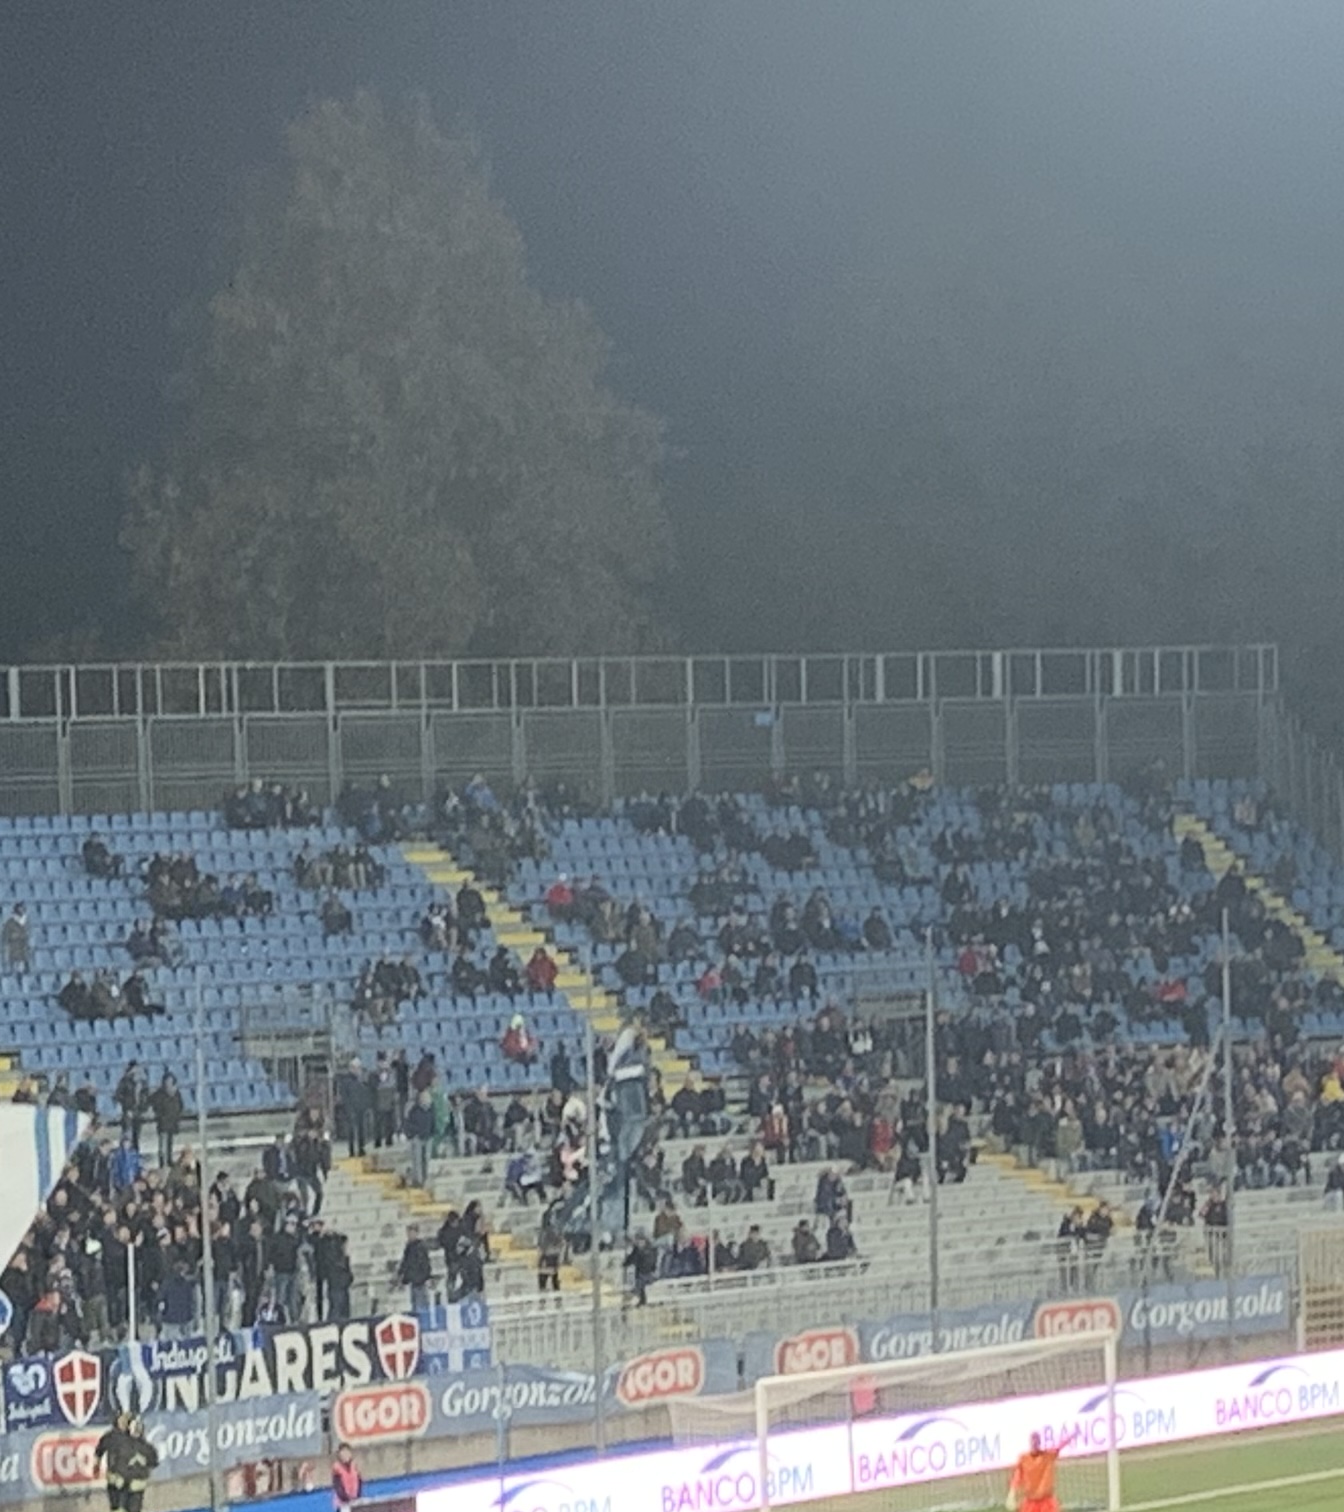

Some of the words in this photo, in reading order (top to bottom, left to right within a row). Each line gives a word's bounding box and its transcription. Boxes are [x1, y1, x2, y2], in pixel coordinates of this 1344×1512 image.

[624, 1356, 696, 1398] IGOR
[343, 1396, 422, 1433] IGOR
[1215, 1387, 1293, 1426] BANCO
[1298, 1380, 1340, 1412] BPM
[1043, 1413, 1127, 1450] BANCO
[1132, 1405, 1176, 1440] BPM
[41, 1442, 104, 1480] IGO
[858, 1445, 947, 1484] BANCO
[954, 1434, 1001, 1468] BPM
[763, 1463, 814, 1499] BPM
